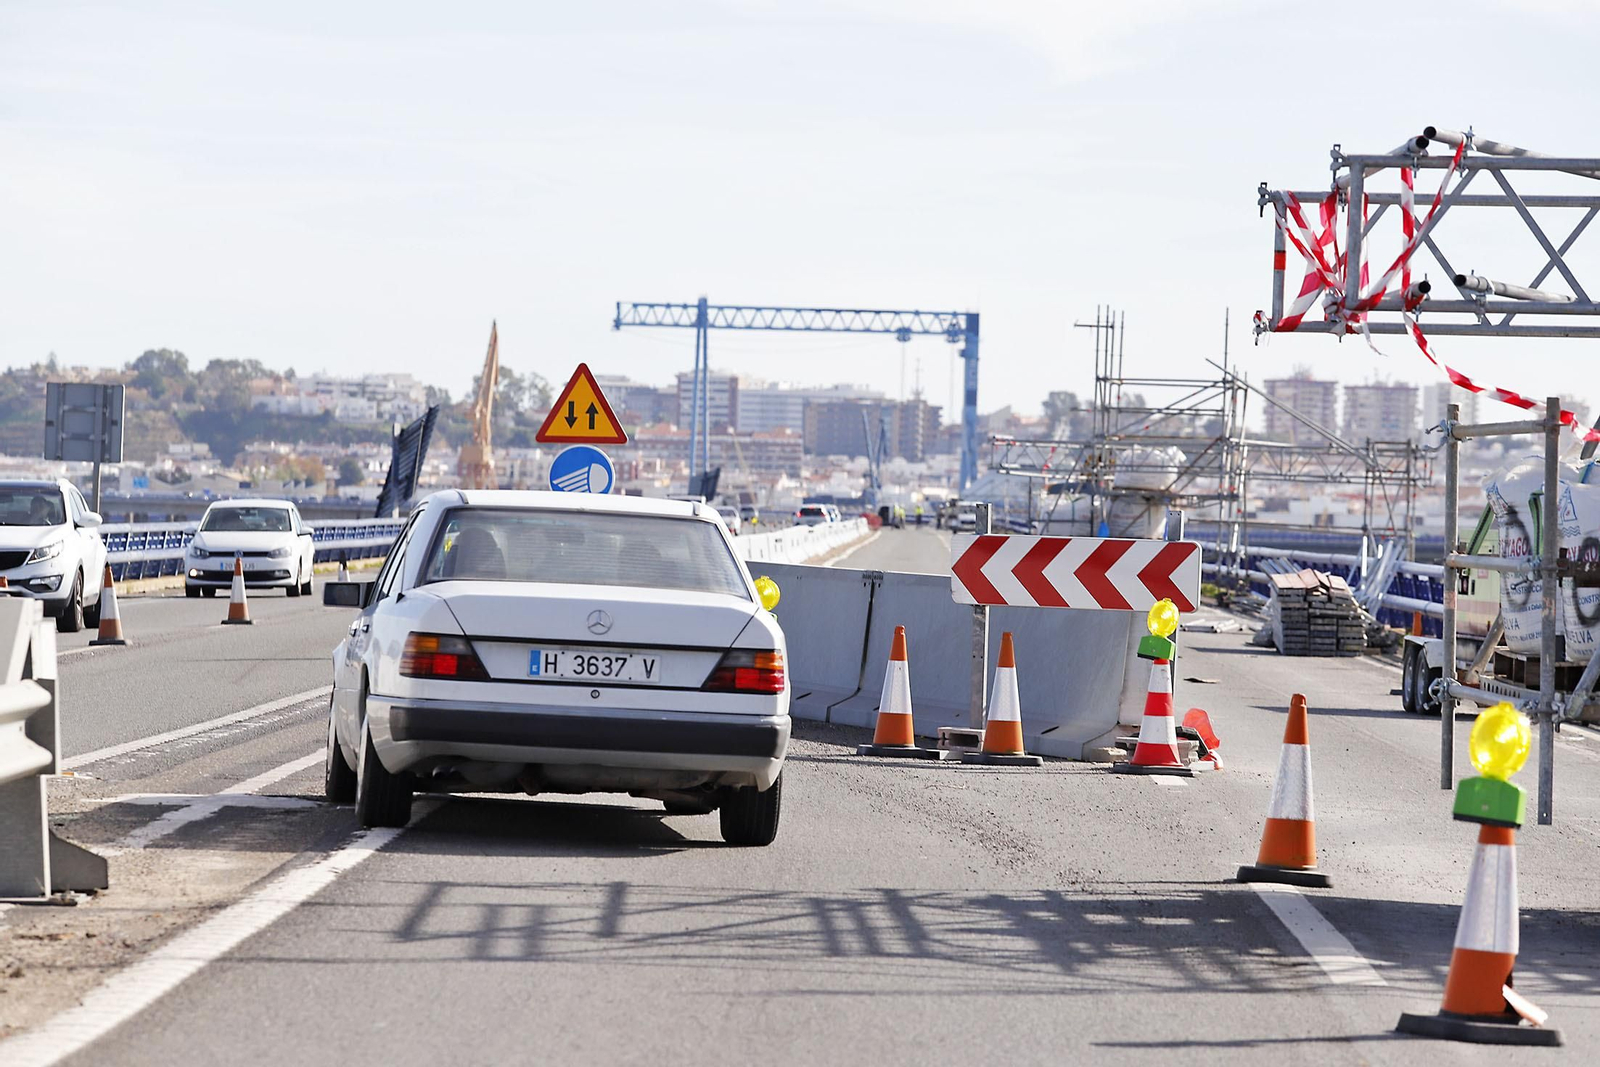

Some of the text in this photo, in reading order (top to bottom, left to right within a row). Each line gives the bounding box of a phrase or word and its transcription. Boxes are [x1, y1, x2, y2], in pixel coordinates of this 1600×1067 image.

[544, 653, 655, 679] H 3637 V
